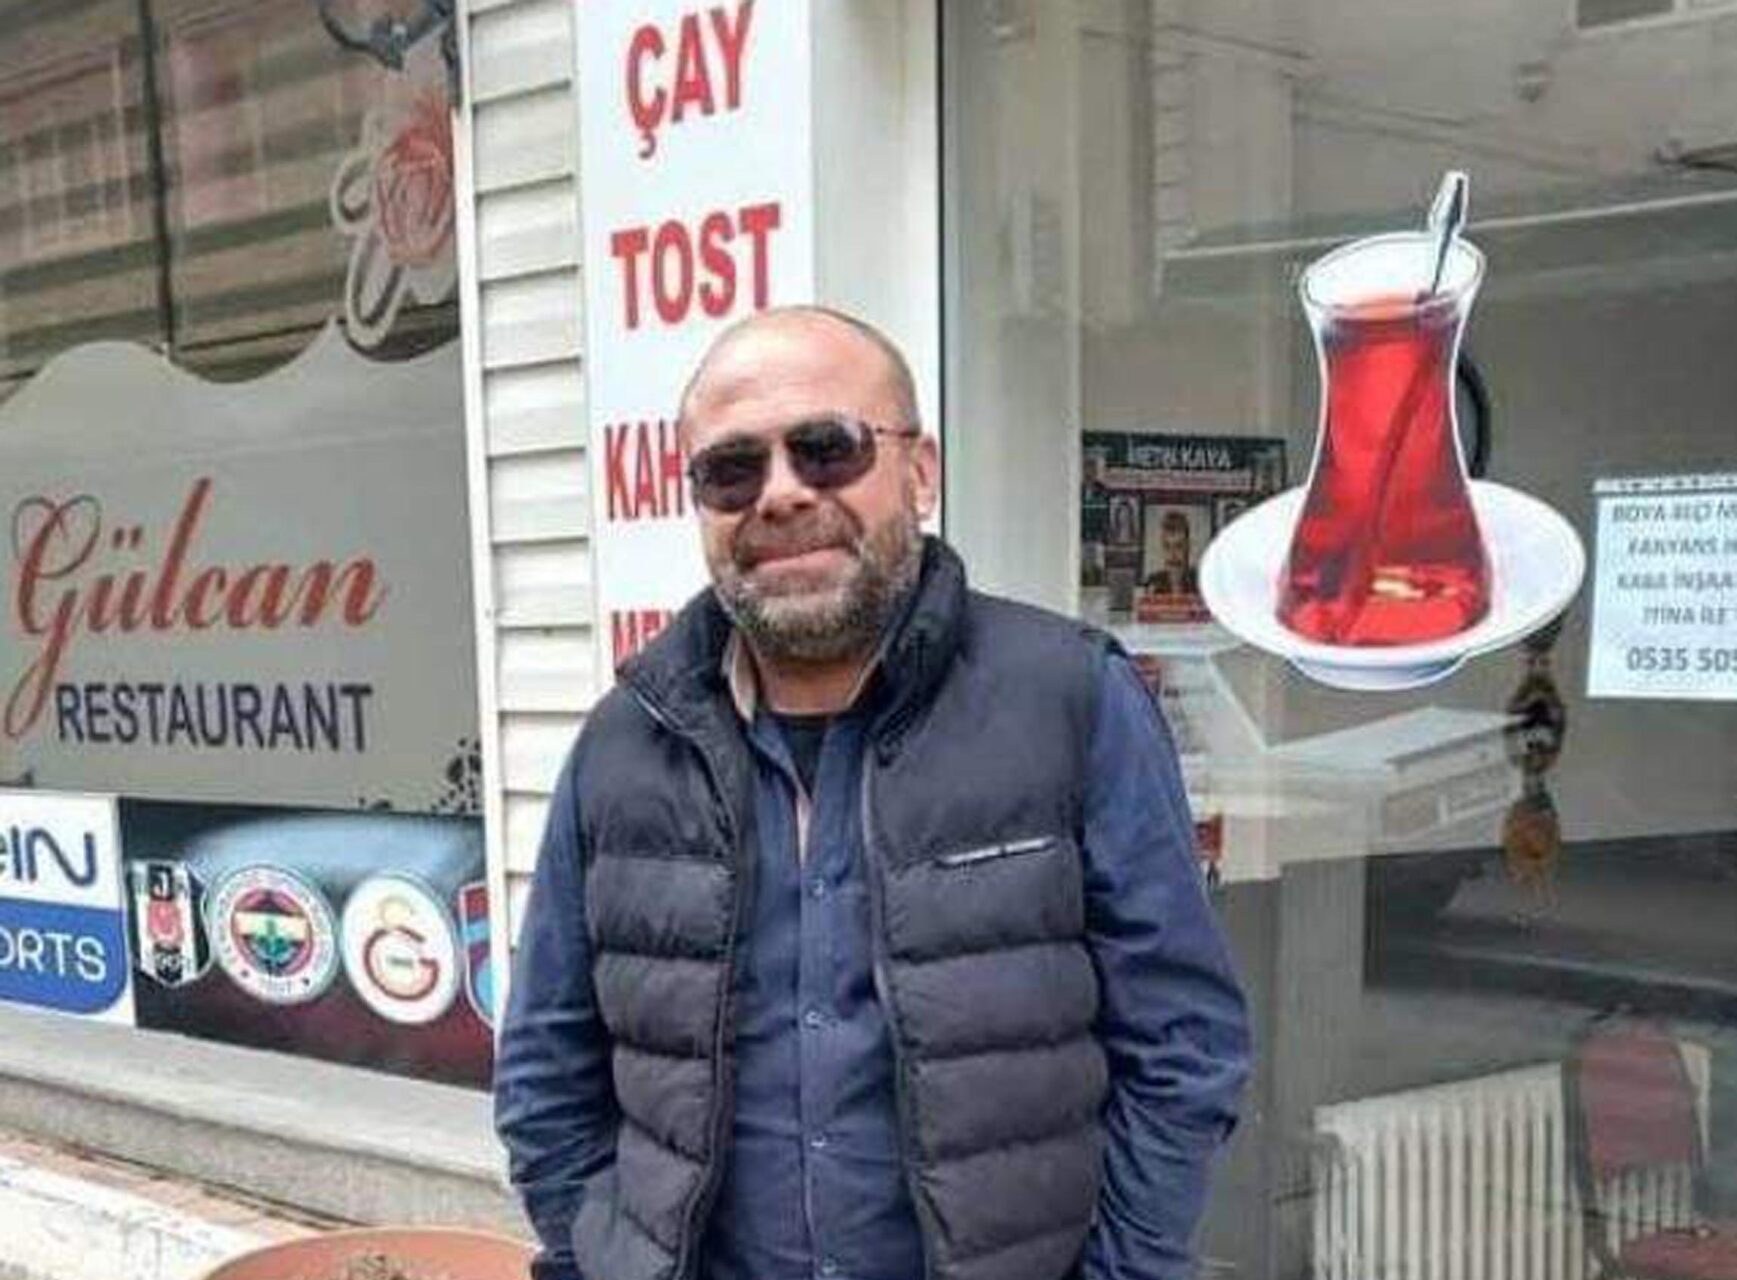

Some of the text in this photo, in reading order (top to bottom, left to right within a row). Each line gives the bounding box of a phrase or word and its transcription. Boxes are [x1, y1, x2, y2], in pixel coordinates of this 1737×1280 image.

[626, 0, 754, 160] ÇAY
[611, 201, 780, 329] TOST
[605, 419, 684, 522] KAH
[6, 476, 388, 739] Gülcan
[1627, 646, 1688, 672] 0535
[57, 682, 373, 752] RESTAURANT
